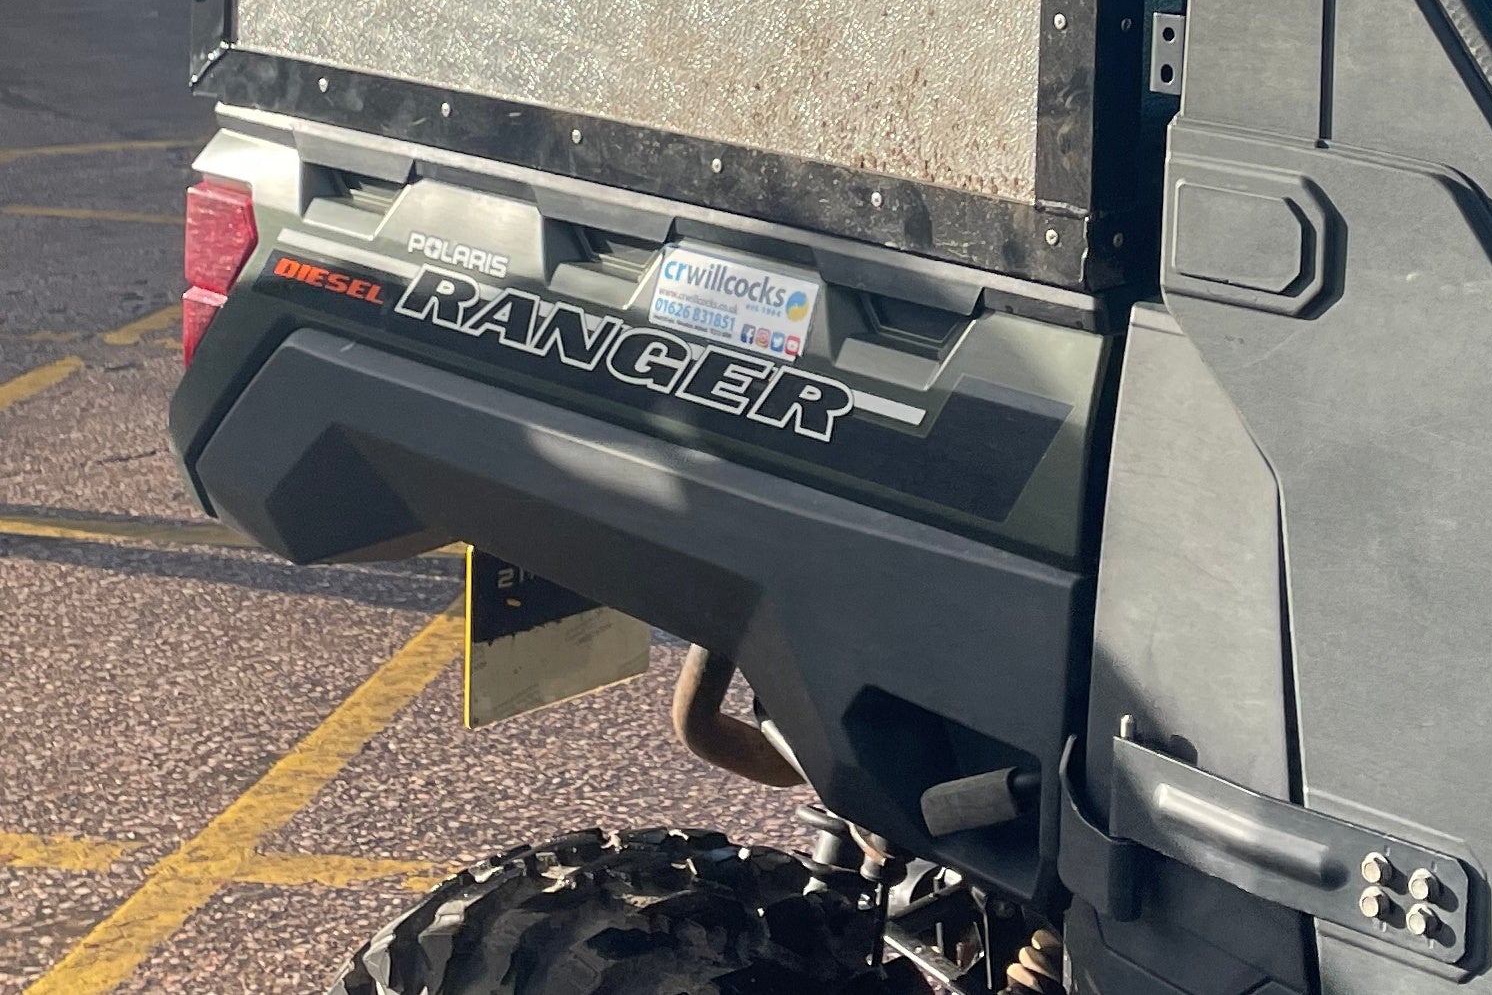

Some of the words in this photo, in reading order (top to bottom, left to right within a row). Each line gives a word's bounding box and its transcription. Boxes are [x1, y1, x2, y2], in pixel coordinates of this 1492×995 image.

[408, 231, 509, 278] POLARIS
[273, 257, 384, 305] DIESEL
[663, 259, 787, 308] crwillcocks
[654, 297, 691, 319] 01626
[692, 307, 736, 332] 831851
[394, 263, 855, 443] RANGER
